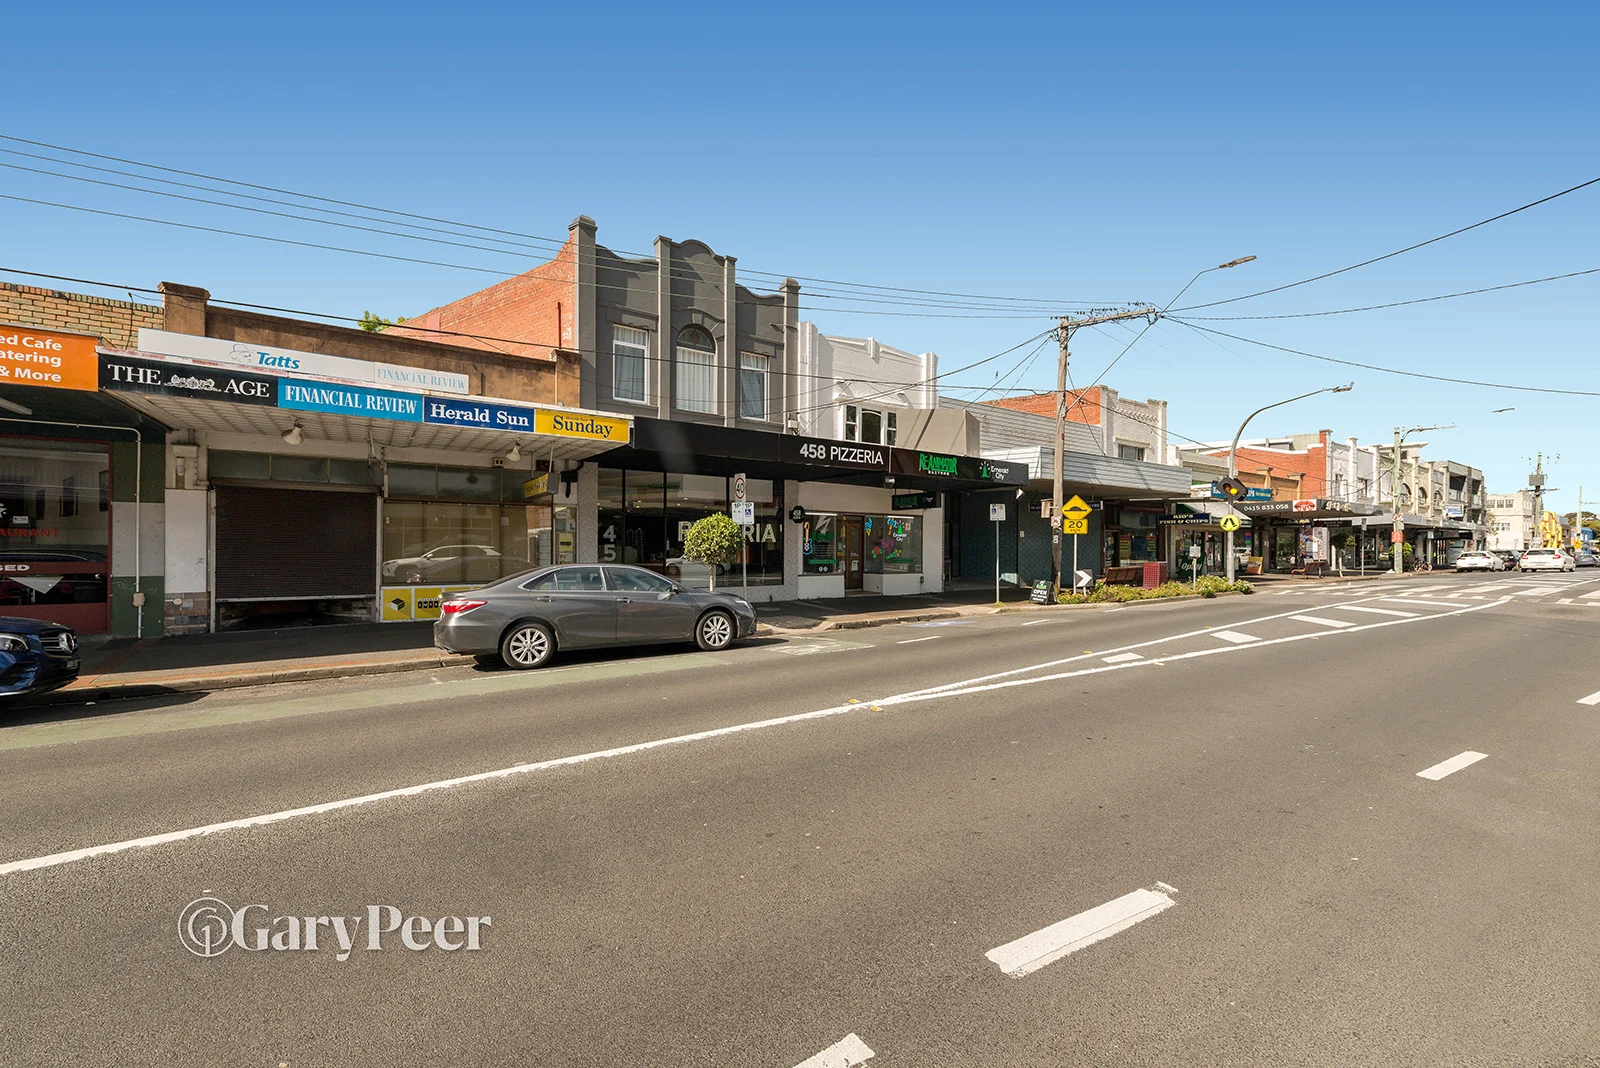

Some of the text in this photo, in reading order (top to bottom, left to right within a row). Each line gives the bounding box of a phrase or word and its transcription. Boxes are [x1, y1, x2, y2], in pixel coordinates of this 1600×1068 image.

[22, 336, 63, 351] Cafe
[256, 351, 301, 370] Tatts
[0, 365, 62, 382] & More
[107, 363, 271, 398] THE AGE
[377, 368, 466, 390] FINANCIAL REVIEW
[288, 385, 418, 415] FINANCIAL REVIEW
[430, 403, 530, 427] Herald Sun
[552, 414, 613, 438] Sunday
[799, 443, 884, 465] 458 PIZZERIA
[990, 465, 1010, 474] Emerald
[995, 472, 1005, 480] City
[736, 482, 744, 494] 40
[1068, 520, 1083, 529] 20
